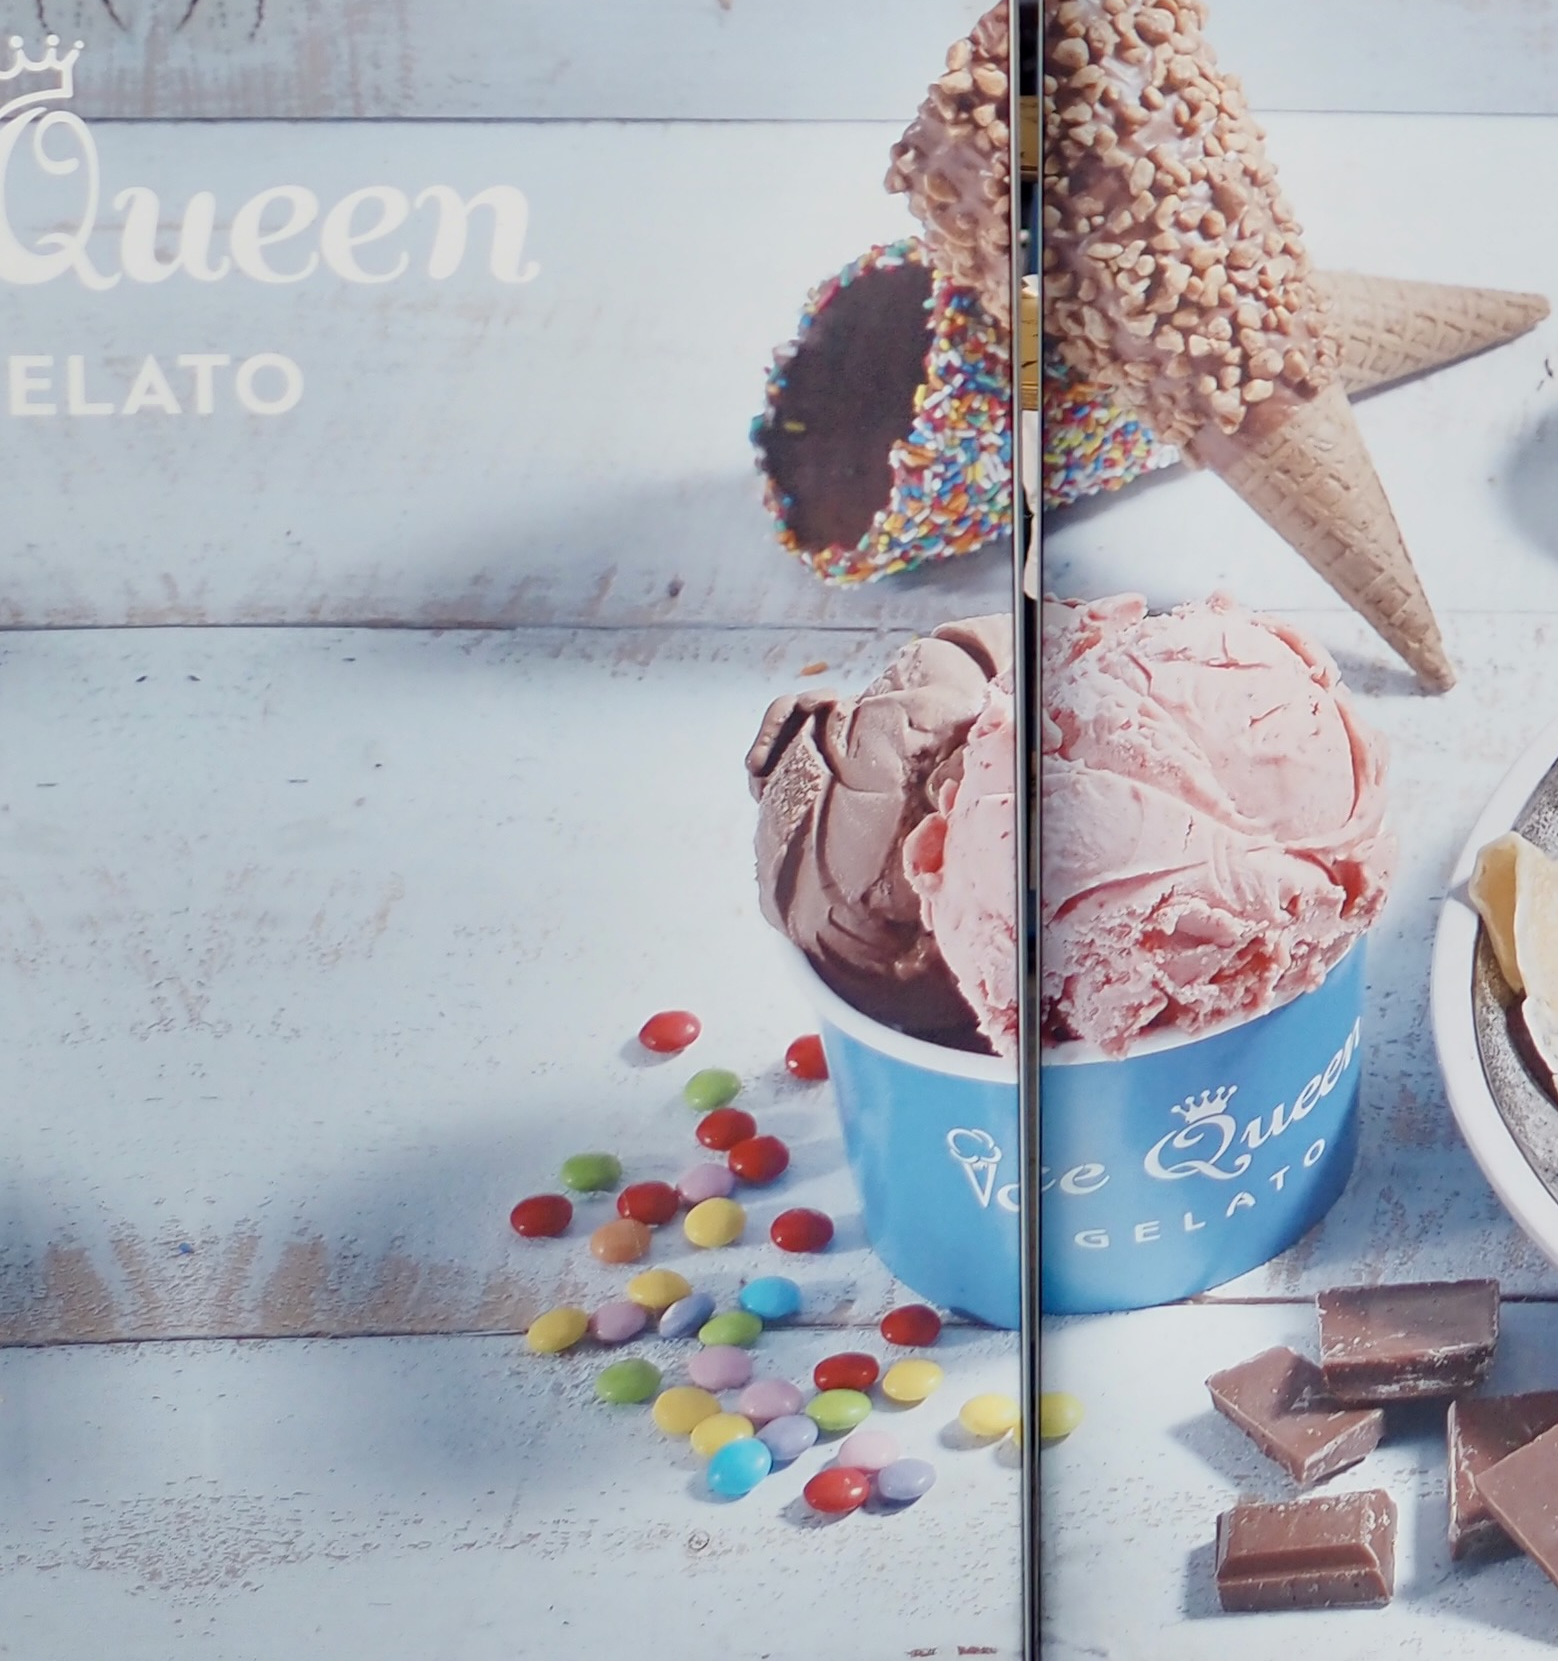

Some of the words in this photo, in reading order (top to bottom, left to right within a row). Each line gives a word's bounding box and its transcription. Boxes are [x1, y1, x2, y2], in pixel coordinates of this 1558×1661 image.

[0, 106, 541, 291] Queen
[9, 352, 305, 416] ELATO
[1143, 1014, 1360, 1181] Queen
[1073, 1138, 1327, 1249] GELATO
